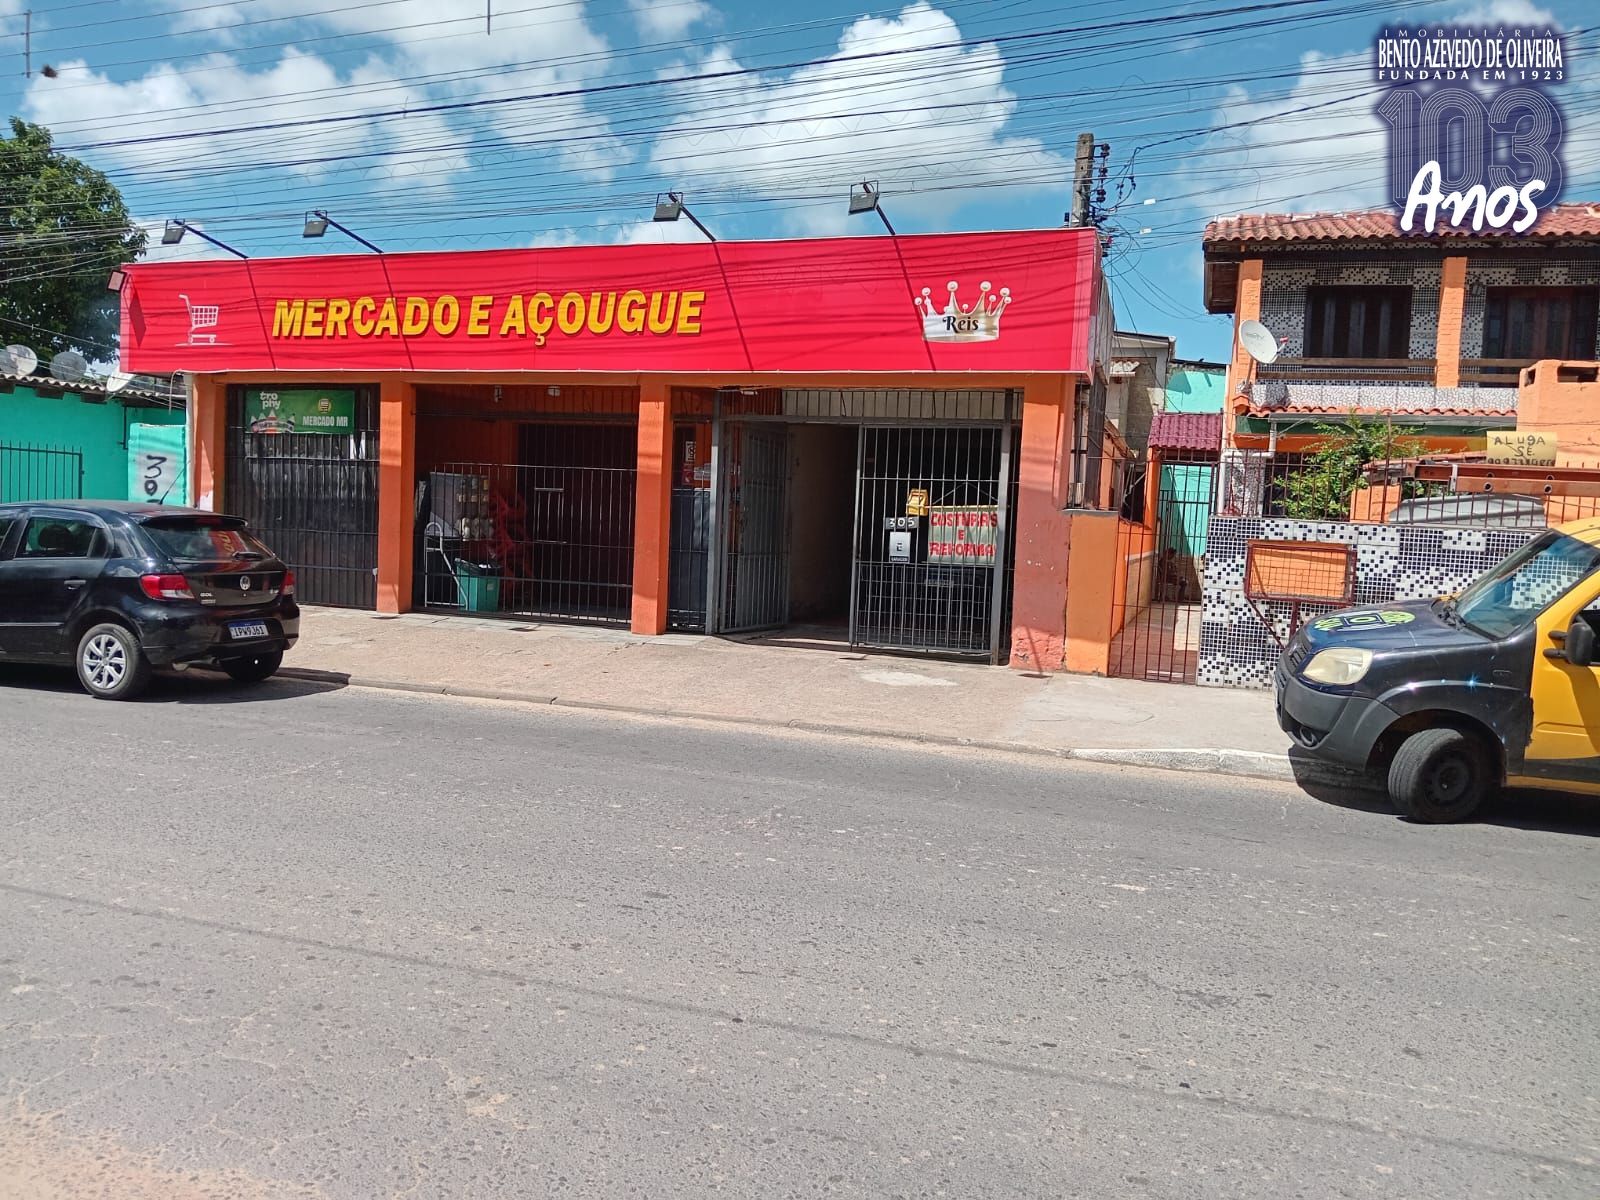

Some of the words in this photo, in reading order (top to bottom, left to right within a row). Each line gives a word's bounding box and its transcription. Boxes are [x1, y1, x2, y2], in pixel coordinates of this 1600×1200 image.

[271, 296, 461, 338] MERCADO
[467, 295, 494, 336] E
[499, 289, 705, 347] AÇOUGUE
[942, 315, 979, 334] Reis
[302, 416, 335, 427] MERCADO
[336, 416, 349, 427] MR
[889, 517, 915, 528] 305
[957, 529, 965, 541] E
